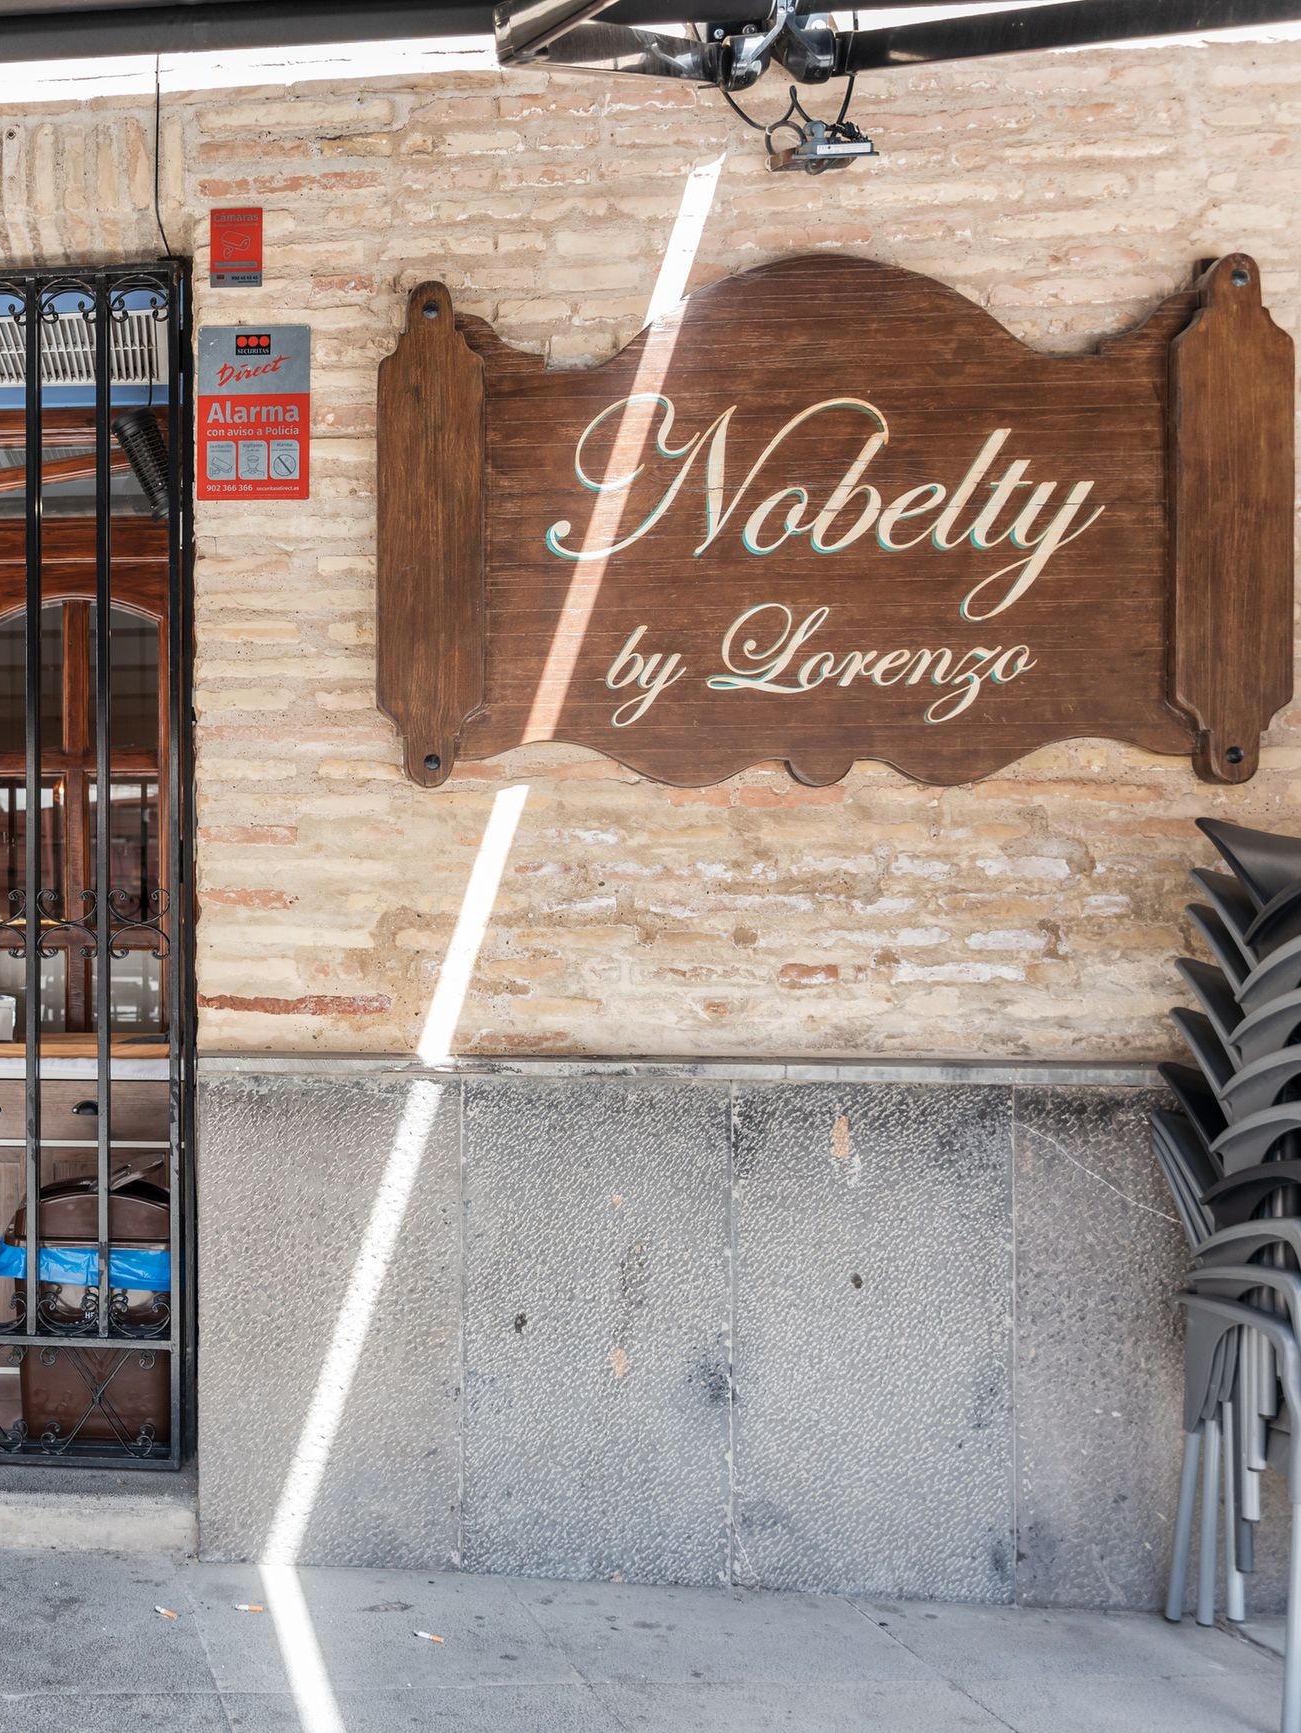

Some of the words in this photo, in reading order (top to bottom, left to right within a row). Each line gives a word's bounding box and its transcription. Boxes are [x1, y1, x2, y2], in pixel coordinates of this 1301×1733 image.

[216, 353, 292, 387] Direct
[207, 400, 300, 424] Alarma
[206, 428, 225, 437] con
[227, 426, 254, 437] aviso
[256, 428, 263, 436] a
[265, 424, 300, 436] Policía
[206, 484, 221, 492] 902
[222, 484, 237, 492] 366
[238, 484, 253, 492] 366
[546, 393, 1105, 621] Nobelty
[605, 625, 686, 728] by
[706, 603, 1037, 725] Lorenzo
